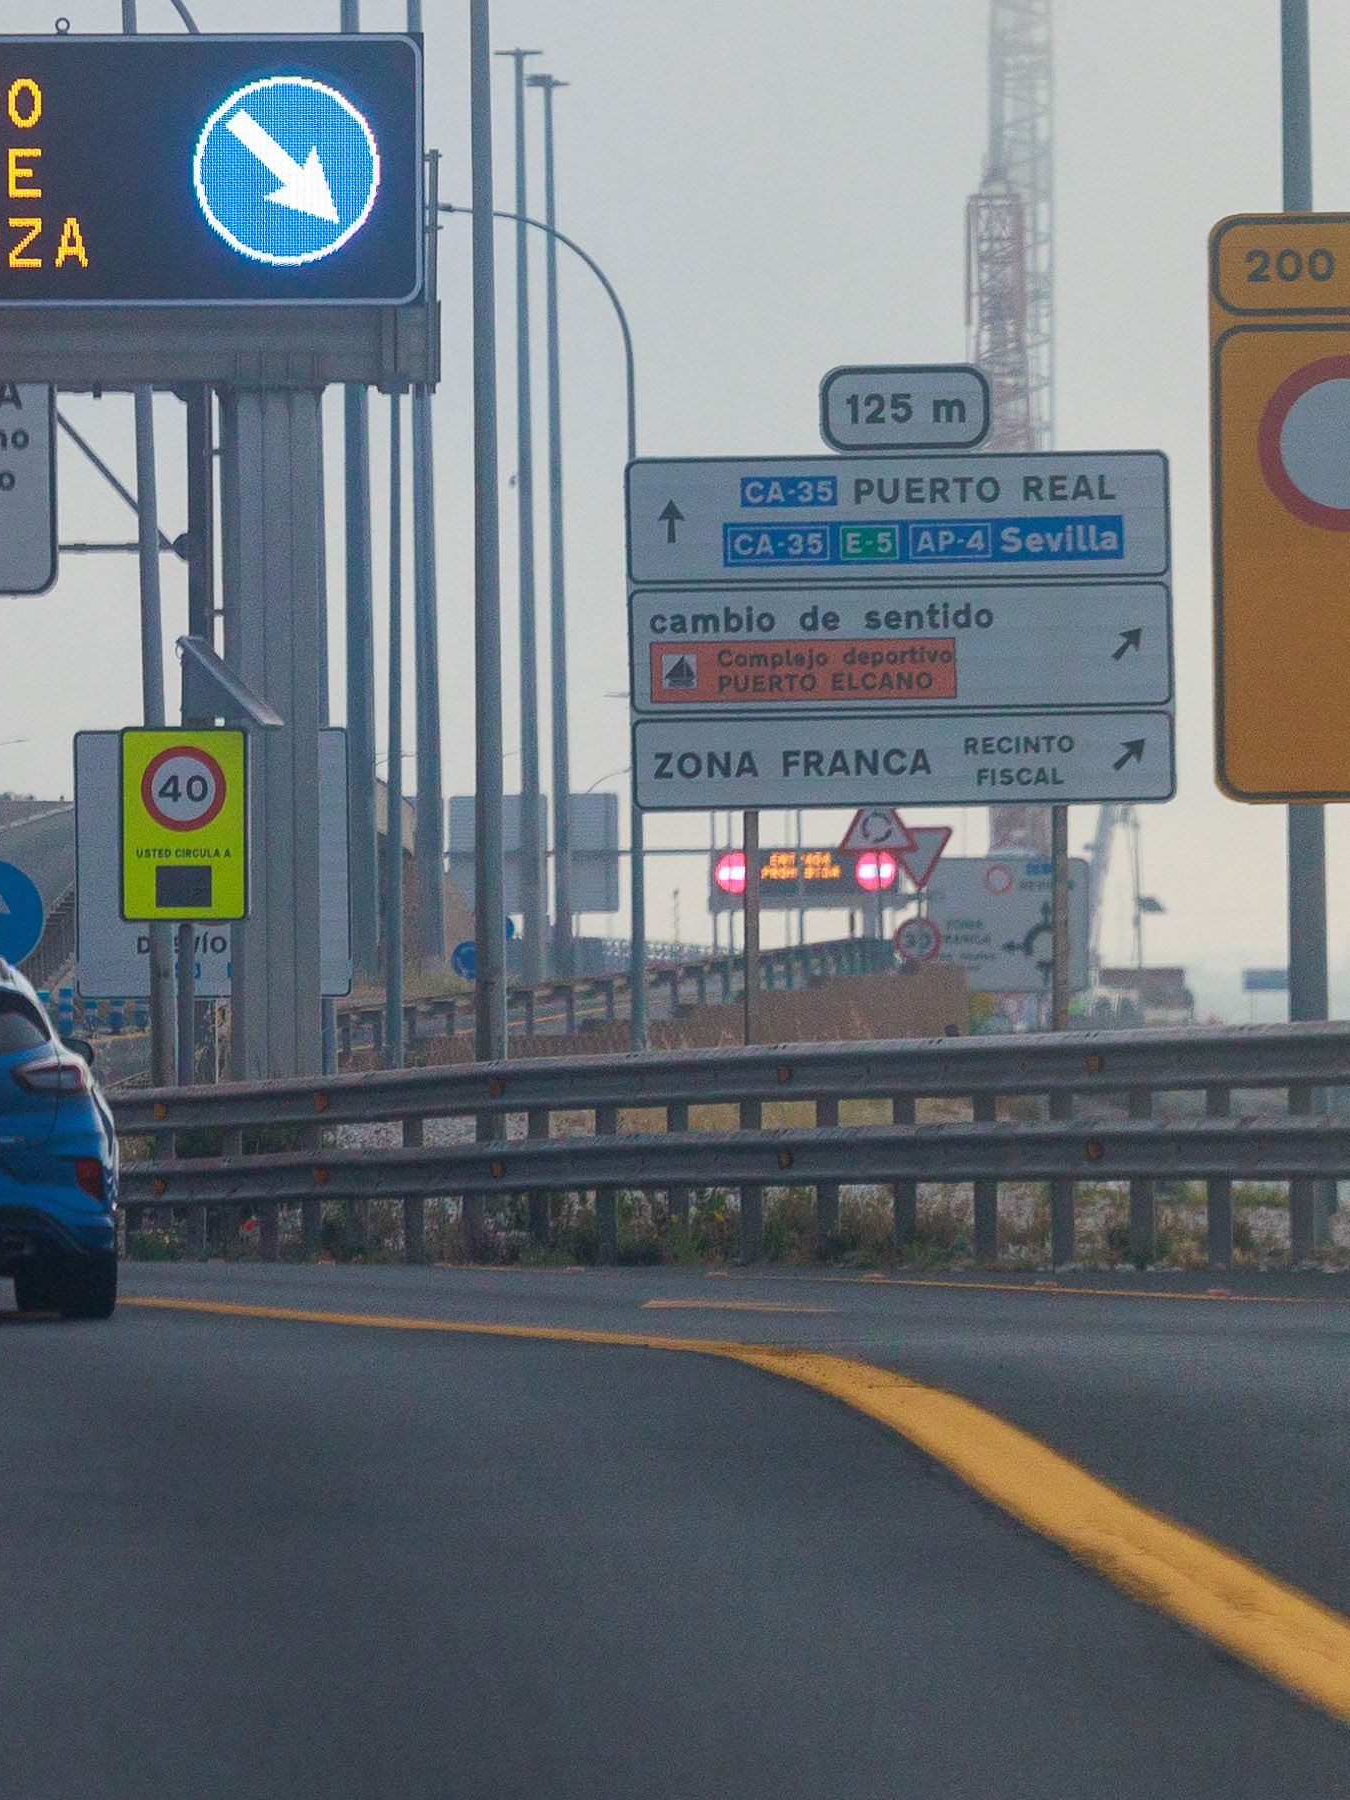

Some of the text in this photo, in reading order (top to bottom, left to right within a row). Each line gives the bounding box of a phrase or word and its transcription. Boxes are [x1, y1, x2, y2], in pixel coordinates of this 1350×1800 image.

[1245, 248, 1336, 282] 200
[845, 394, 967, 425] 125 m
[744, 474, 1116, 505] CA-35 PUERTO REAL
[733, 523, 1118, 556] CA-35 E-5 AP-4 Sevilla
[649, 601, 994, 634] cambio de sentido
[716, 646, 953, 671] Complejo deportivo
[717, 671, 934, 694] PUERTO ELCANO
[963, 735, 1075, 756] RECINTO
[653, 748, 932, 779] ZONA FRANCA
[976, 766, 1065, 787] FISCAL
[157, 774, 209, 803] 40
[135, 848, 232, 858] USTED CIRCULA A
[137, 930, 228, 954] DÍO
